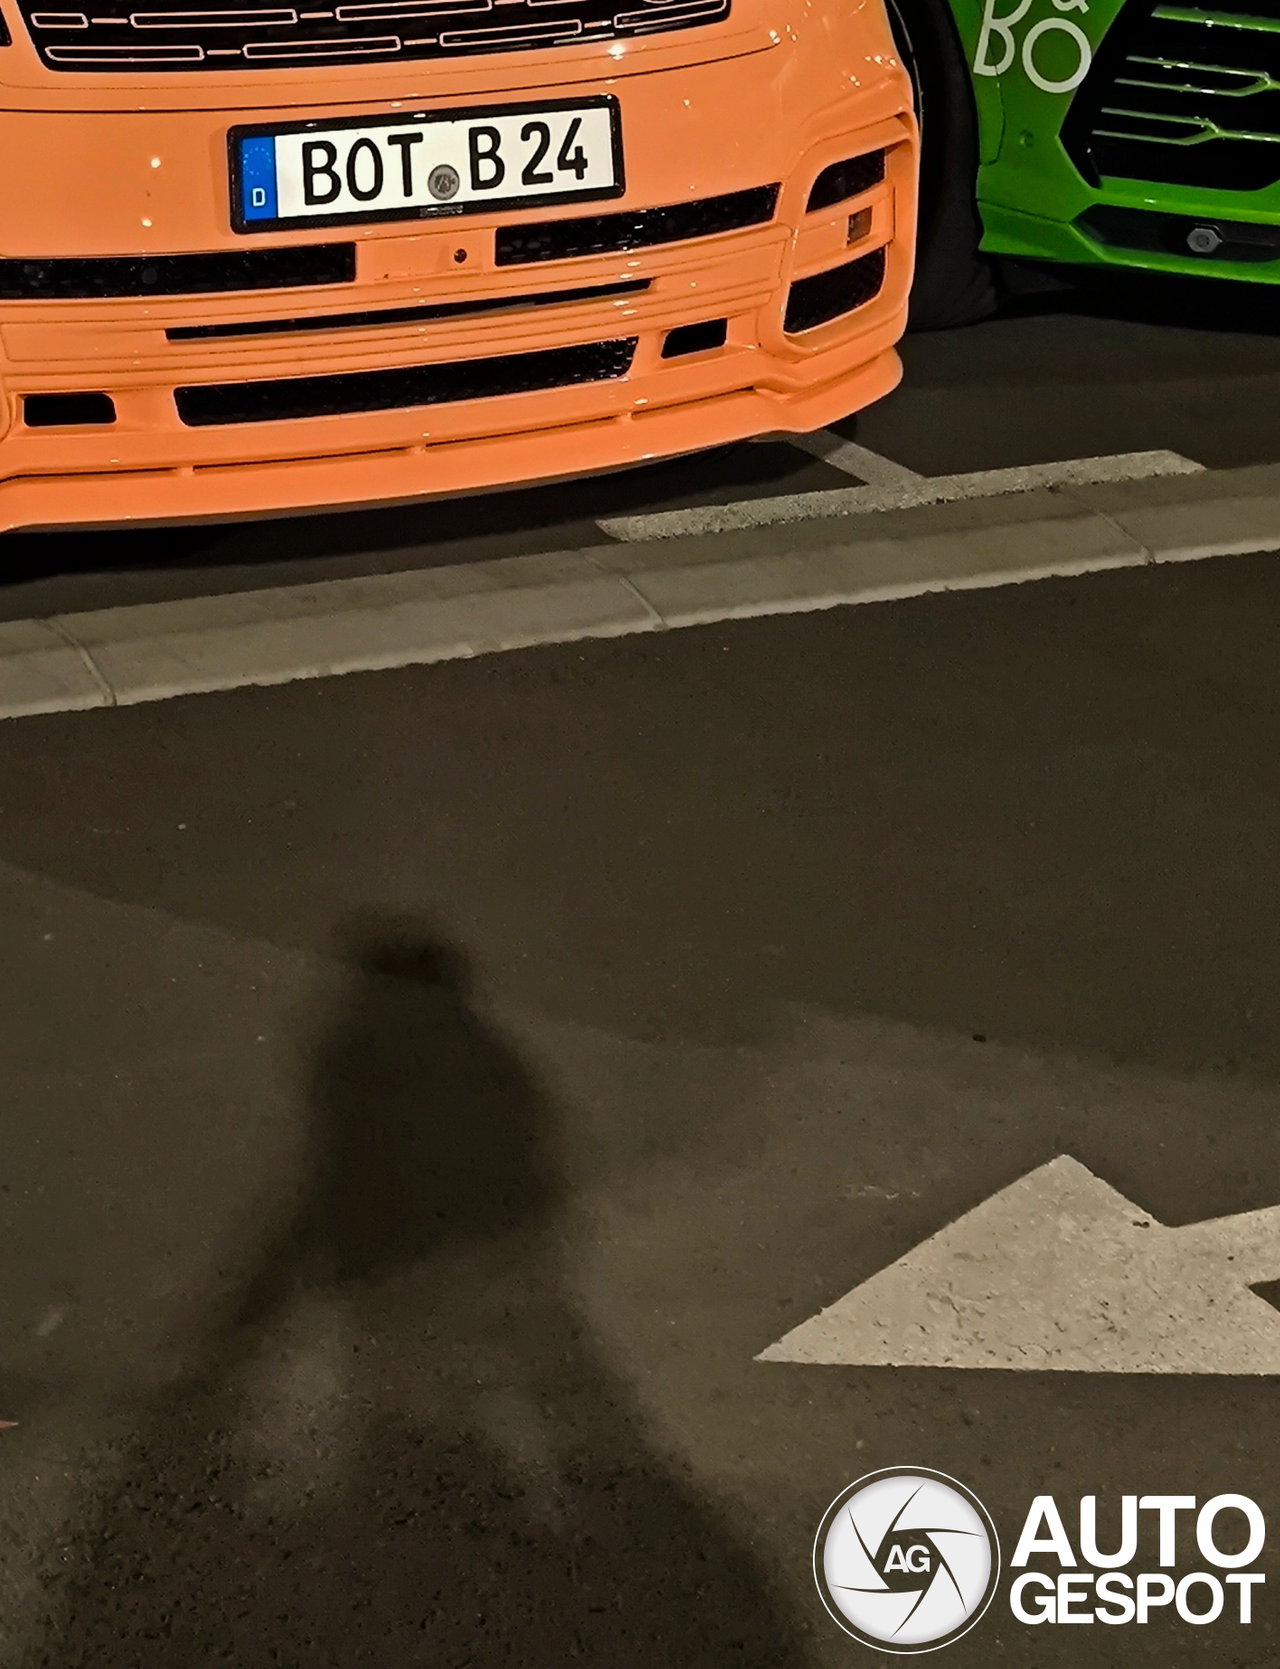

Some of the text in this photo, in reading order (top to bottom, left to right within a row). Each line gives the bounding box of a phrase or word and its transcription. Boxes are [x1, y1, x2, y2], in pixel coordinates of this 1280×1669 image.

[301, 117, 588, 207] BOT B 24
[251, 187, 266, 207] D
